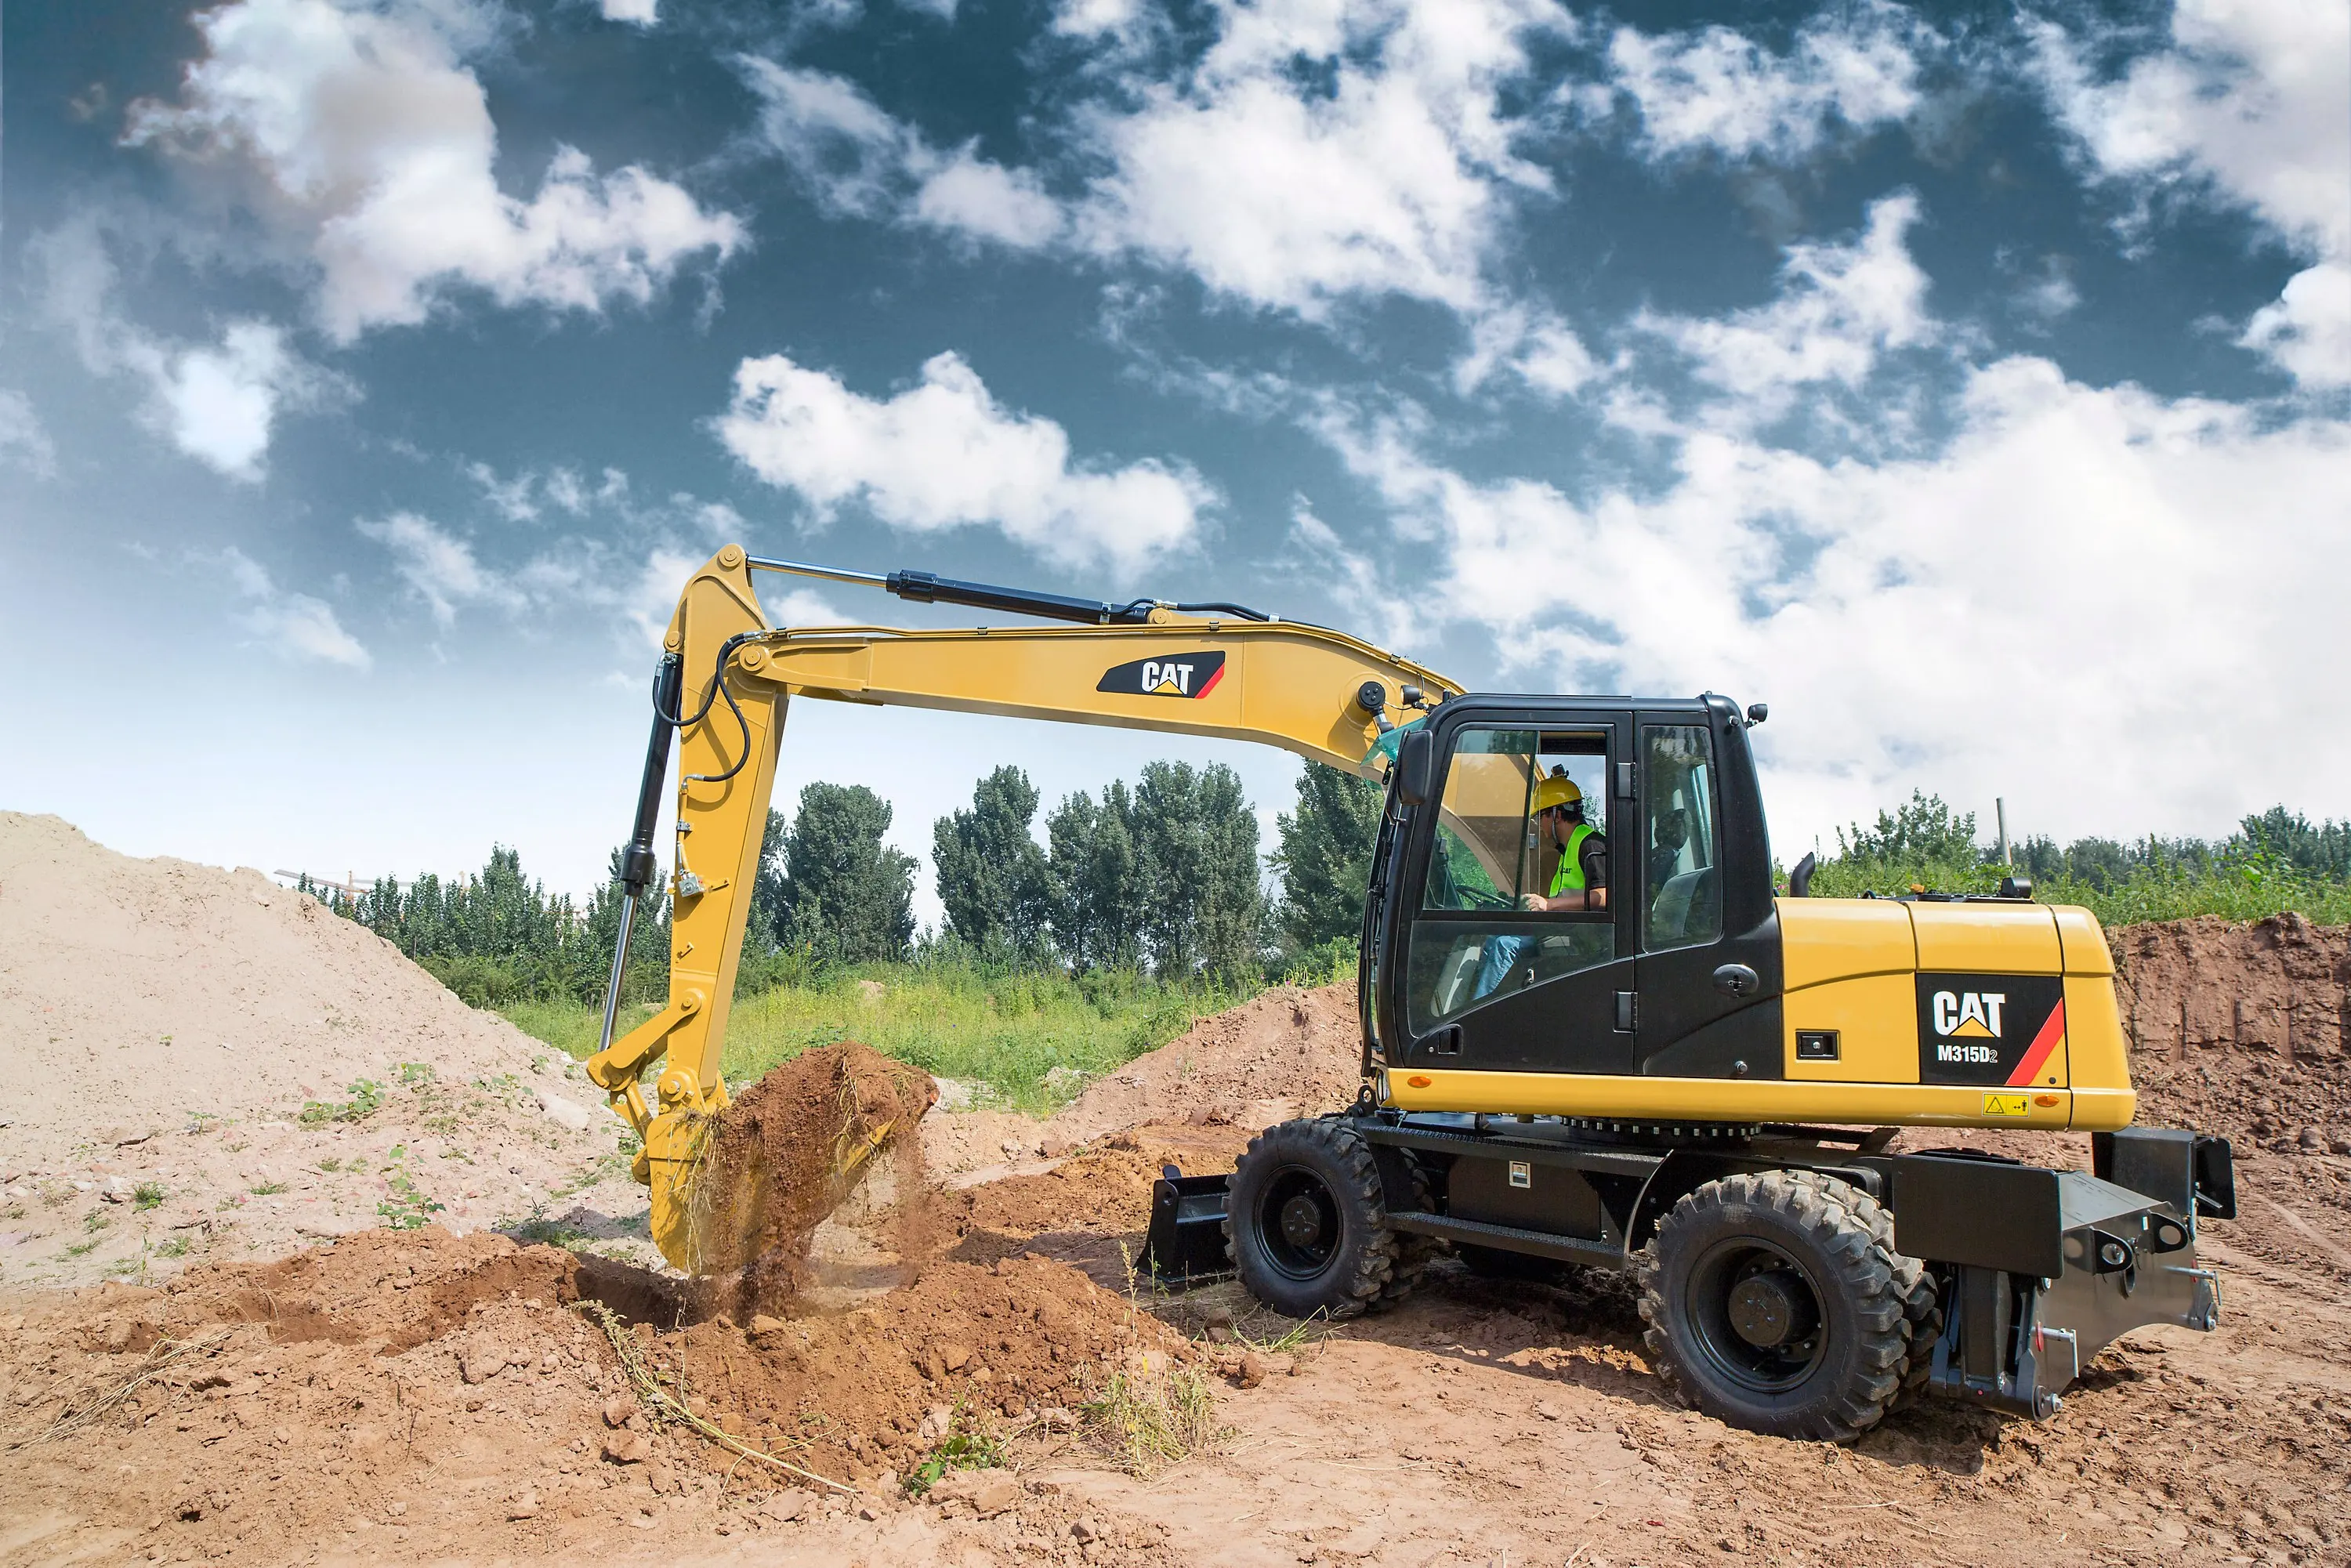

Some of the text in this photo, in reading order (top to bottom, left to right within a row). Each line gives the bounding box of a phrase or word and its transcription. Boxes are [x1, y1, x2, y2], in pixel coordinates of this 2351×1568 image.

[1142, 661, 1194, 695] CAT
[1933, 990, 2005, 1037] CAT
[1937, 1045, 1998, 1063] M315D2
